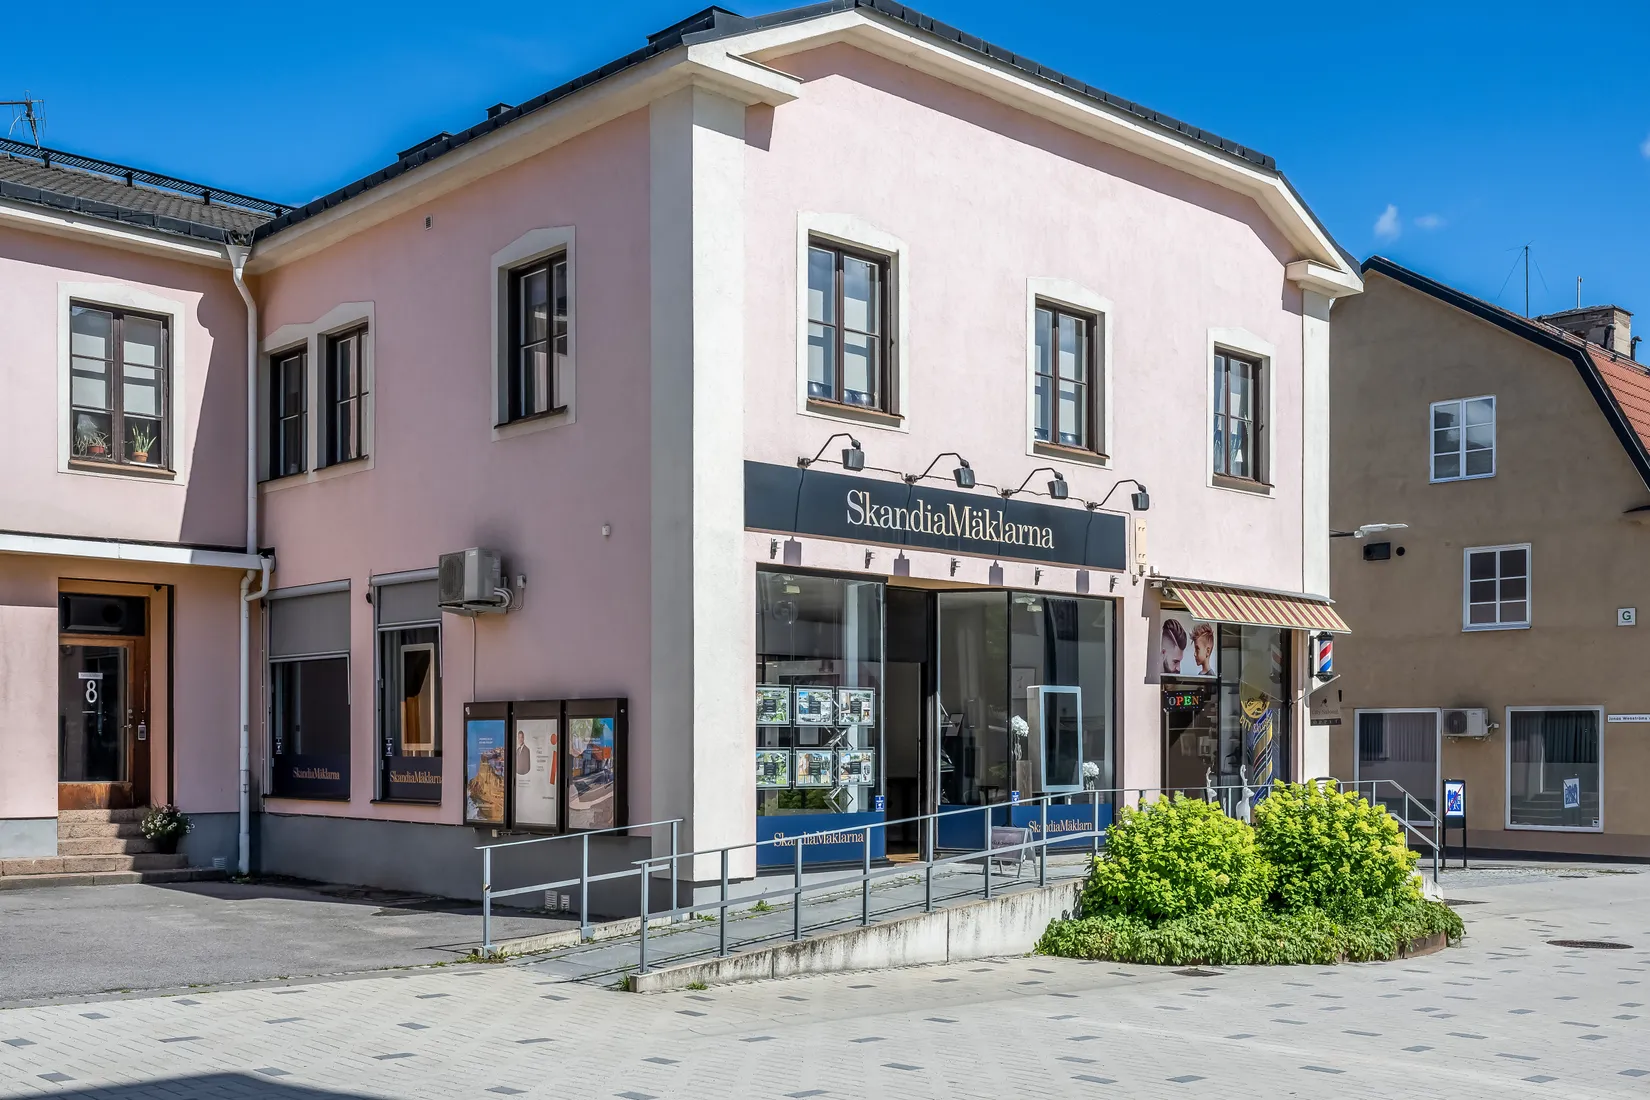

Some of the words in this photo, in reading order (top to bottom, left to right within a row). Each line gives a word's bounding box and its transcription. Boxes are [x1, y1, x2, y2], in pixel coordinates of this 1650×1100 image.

[846, 489, 1055, 549] SkandiaMäklarna
[1621, 610, 1632, 621] G
[85, 680, 98, 703] 8
[1168, 695, 1199, 706] OPEN
[292, 766, 341, 780] SkandiaMäklarna
